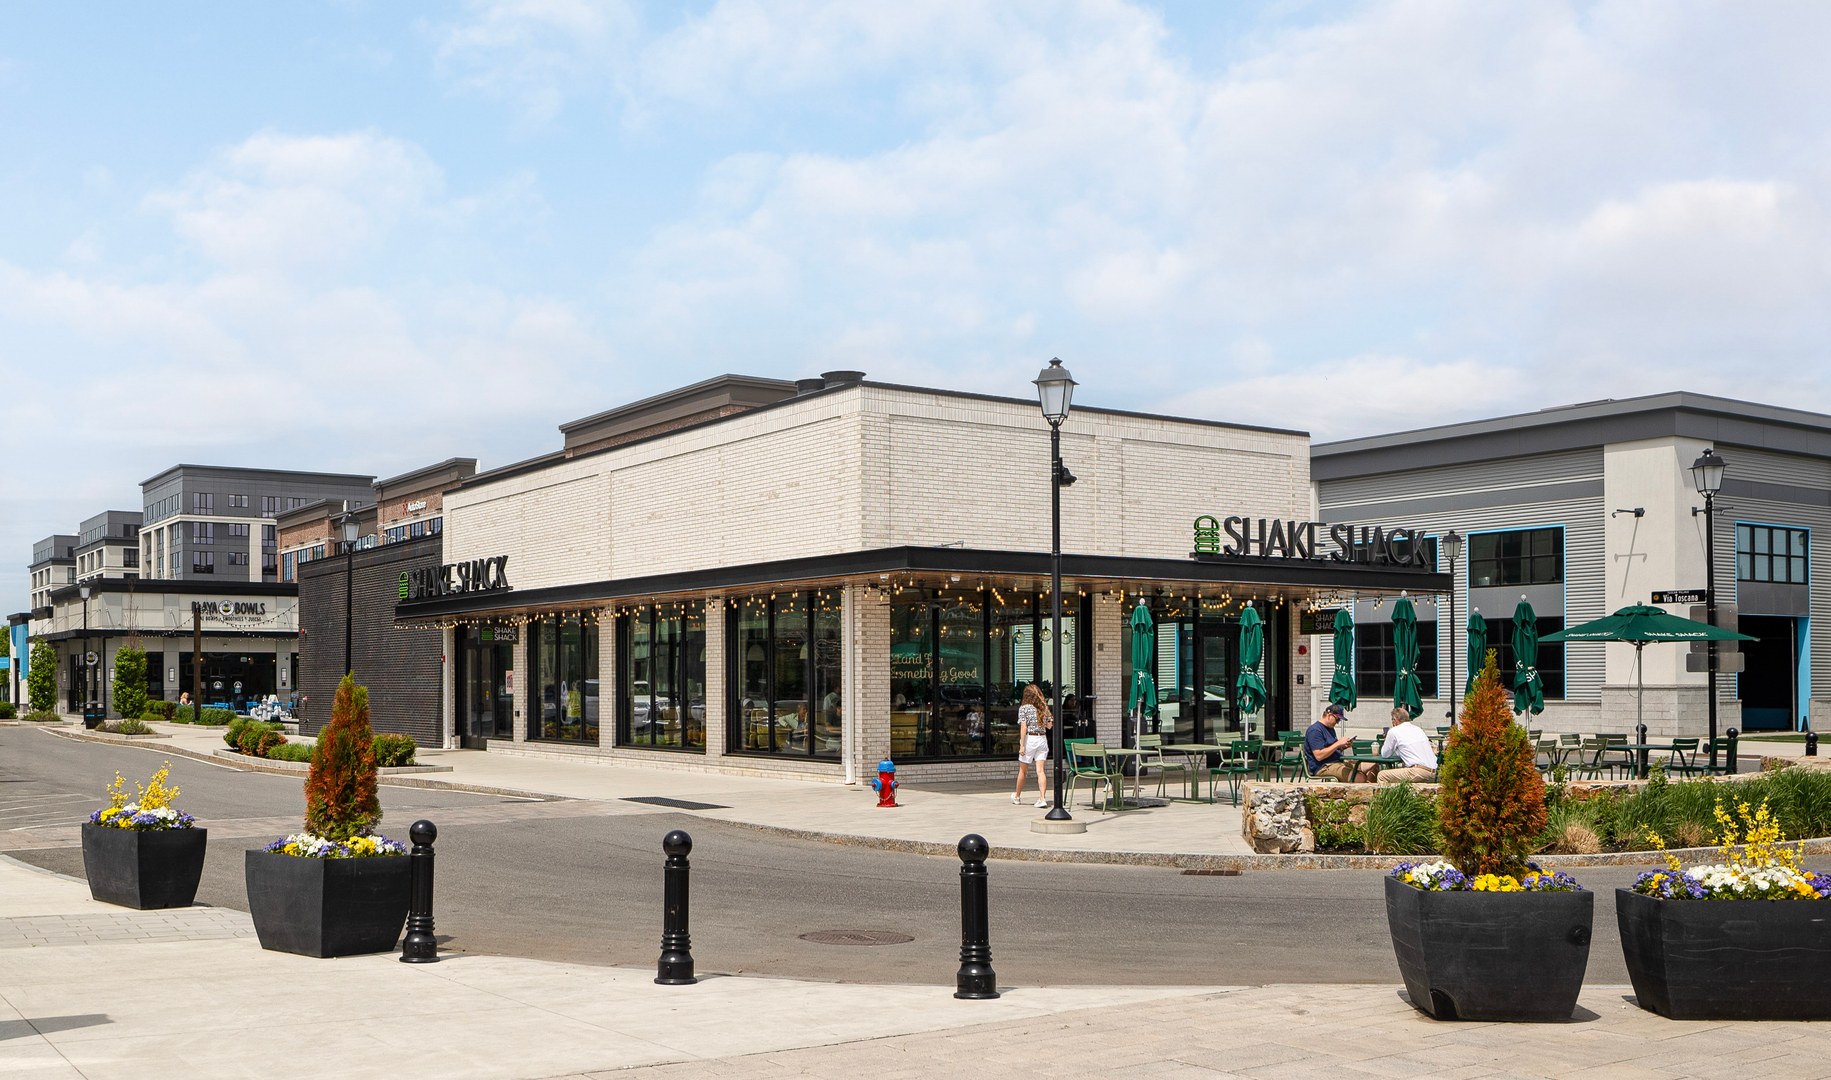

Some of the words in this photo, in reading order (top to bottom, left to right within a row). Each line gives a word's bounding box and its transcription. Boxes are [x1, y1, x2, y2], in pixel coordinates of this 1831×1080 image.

[1223, 516, 1327, 560] SHAKE
[1330, 523, 1428, 565] SHACK
[410, 564, 456, 598] SHAKE
[456, 555, 509, 593] SHACK
[1663, 594, 1673, 602] Via
[1675, 594, 1698, 602] Toscana
[235, 602, 266, 615] BOWLS
[494, 626, 517, 634] SHAKE
[1315, 622, 1334, 630] SHAC
[924, 652, 944, 668] Fr
[891, 666, 948, 682] Somethig
[949, 667, 978, 682] Good
